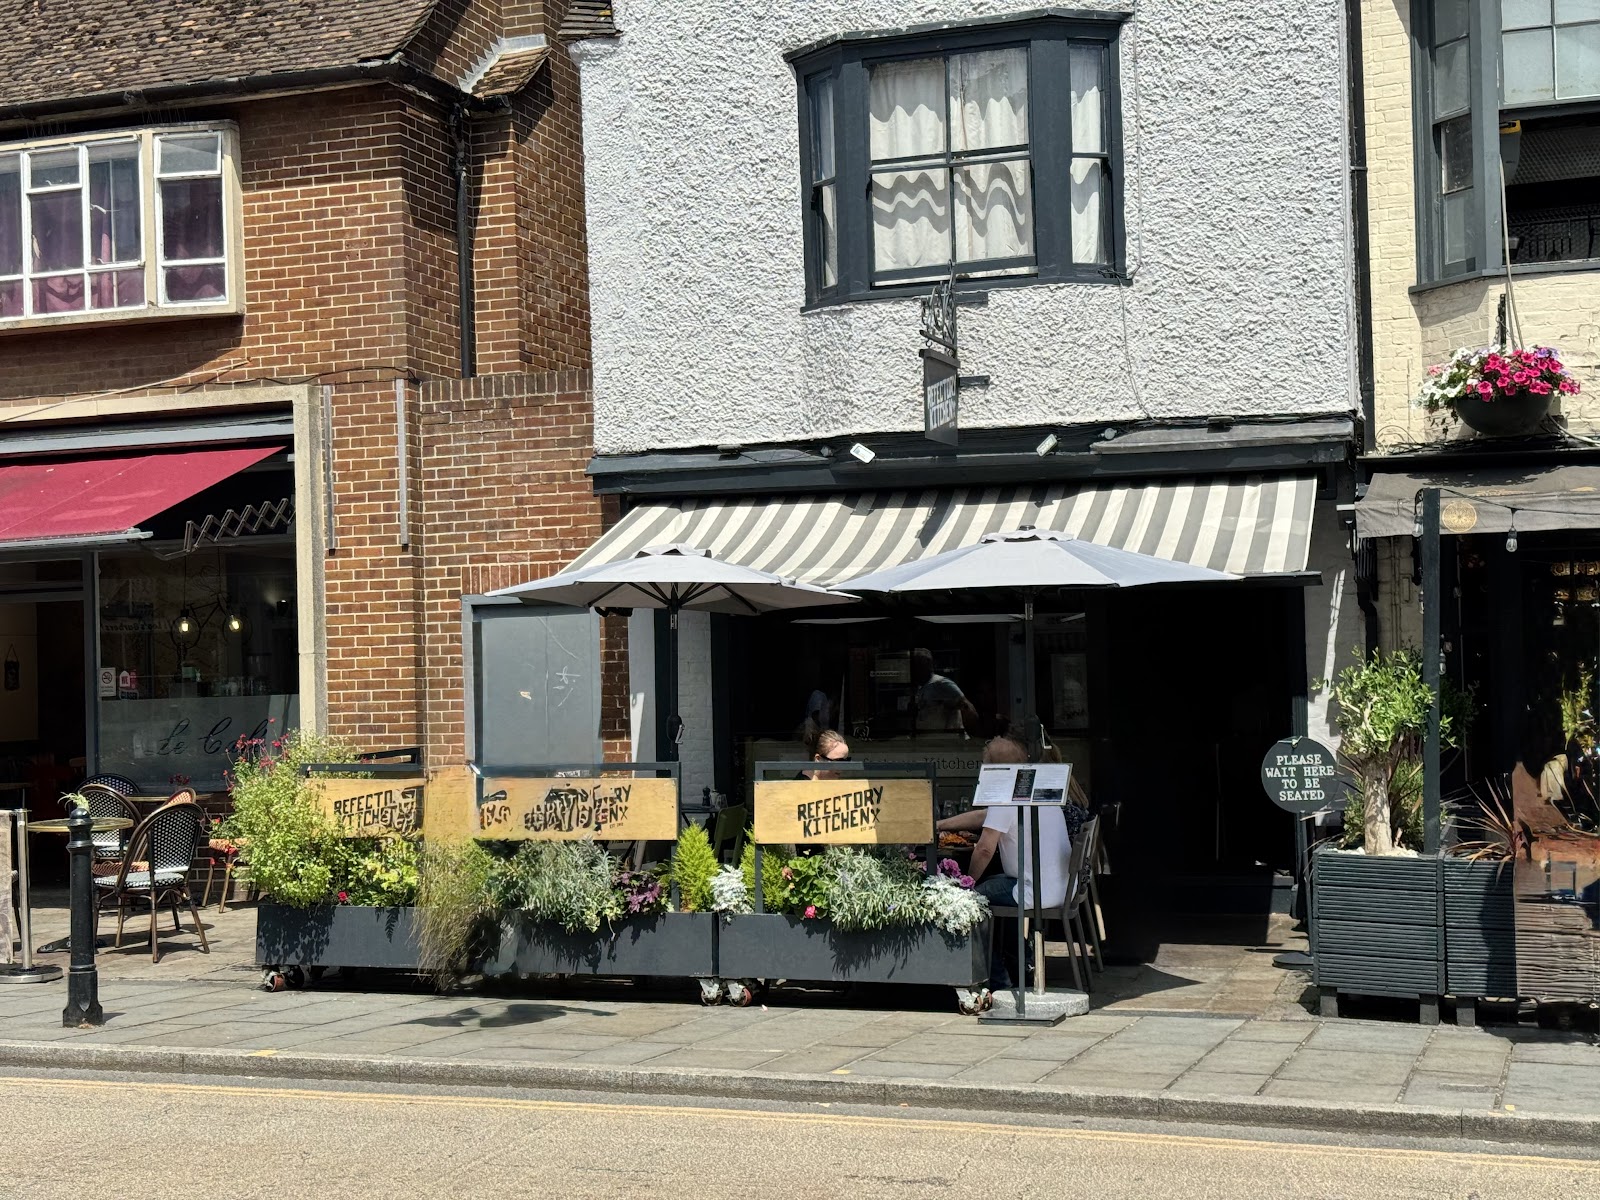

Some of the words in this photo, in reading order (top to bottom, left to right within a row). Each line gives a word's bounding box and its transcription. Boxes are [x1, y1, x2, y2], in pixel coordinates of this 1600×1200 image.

[157, 717, 190, 756] Le
[1276, 754, 1322, 766] PLEASE
[1265, 766, 1297, 778] WAIT
[1303, 765, 1335, 777] HERE
[1281, 779, 1298, 789] TO
[1304, 778, 1321, 789] BE
[1278, 790, 1326, 802] SEATED
[797, 785, 884, 822] REFECTORY
[803, 807, 871, 838] KITCHEN
